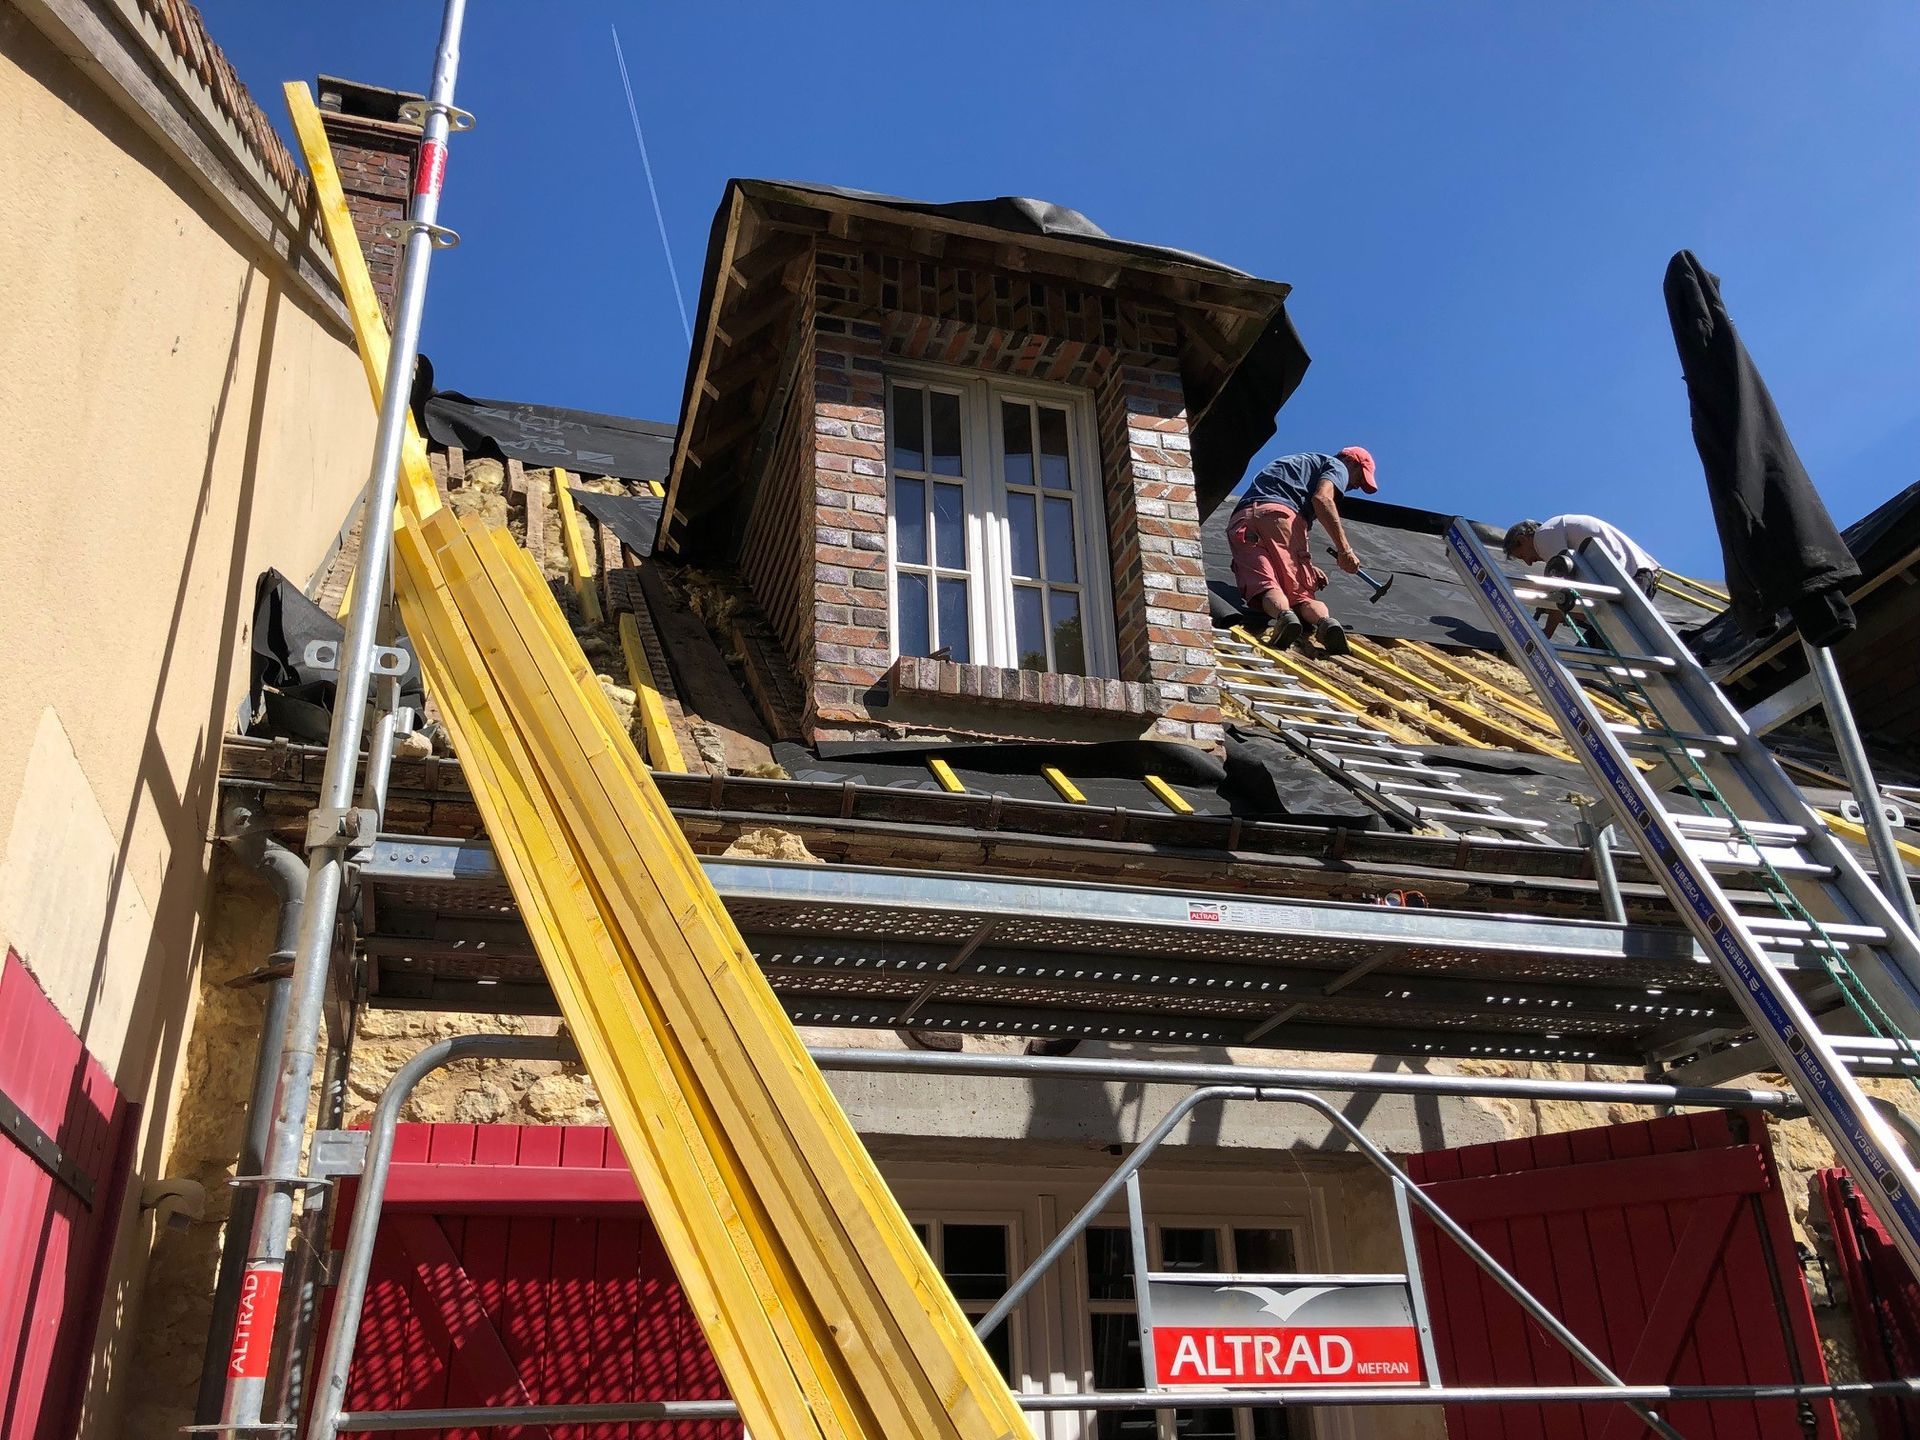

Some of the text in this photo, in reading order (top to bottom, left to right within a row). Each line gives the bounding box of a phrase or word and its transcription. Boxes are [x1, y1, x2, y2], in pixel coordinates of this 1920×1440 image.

[1191, 912, 1218, 921] ALTRAD
[1721, 935, 1751, 978] TUBESCA
[231, 1274, 258, 1374] ALTRAD
[1170, 1335, 1409, 1376] ALTRAD MEFRAN
